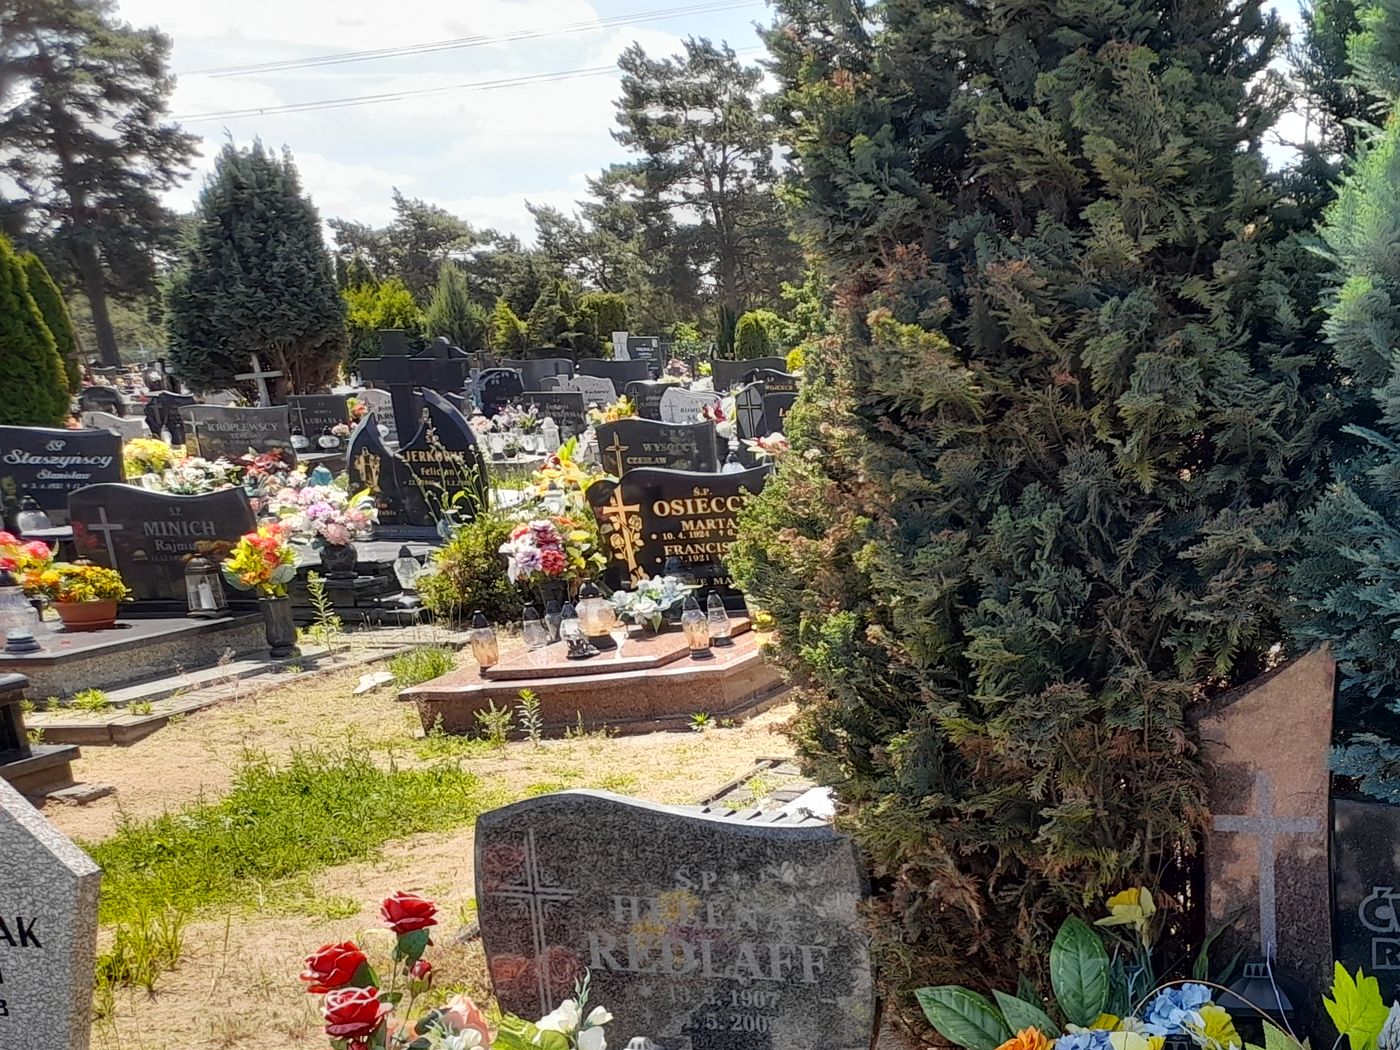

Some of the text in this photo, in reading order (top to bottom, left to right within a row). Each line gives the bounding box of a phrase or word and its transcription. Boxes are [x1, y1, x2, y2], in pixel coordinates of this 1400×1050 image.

[420, 466, 455, 477] Felican
[143, 520, 217, 537] MINICH
[680, 518, 738, 532] MARTA
[154, 539, 198, 553] Rajmu
[663, 541, 733, 556] FRANCIS
[586, 931, 829, 983] REDLAFF
